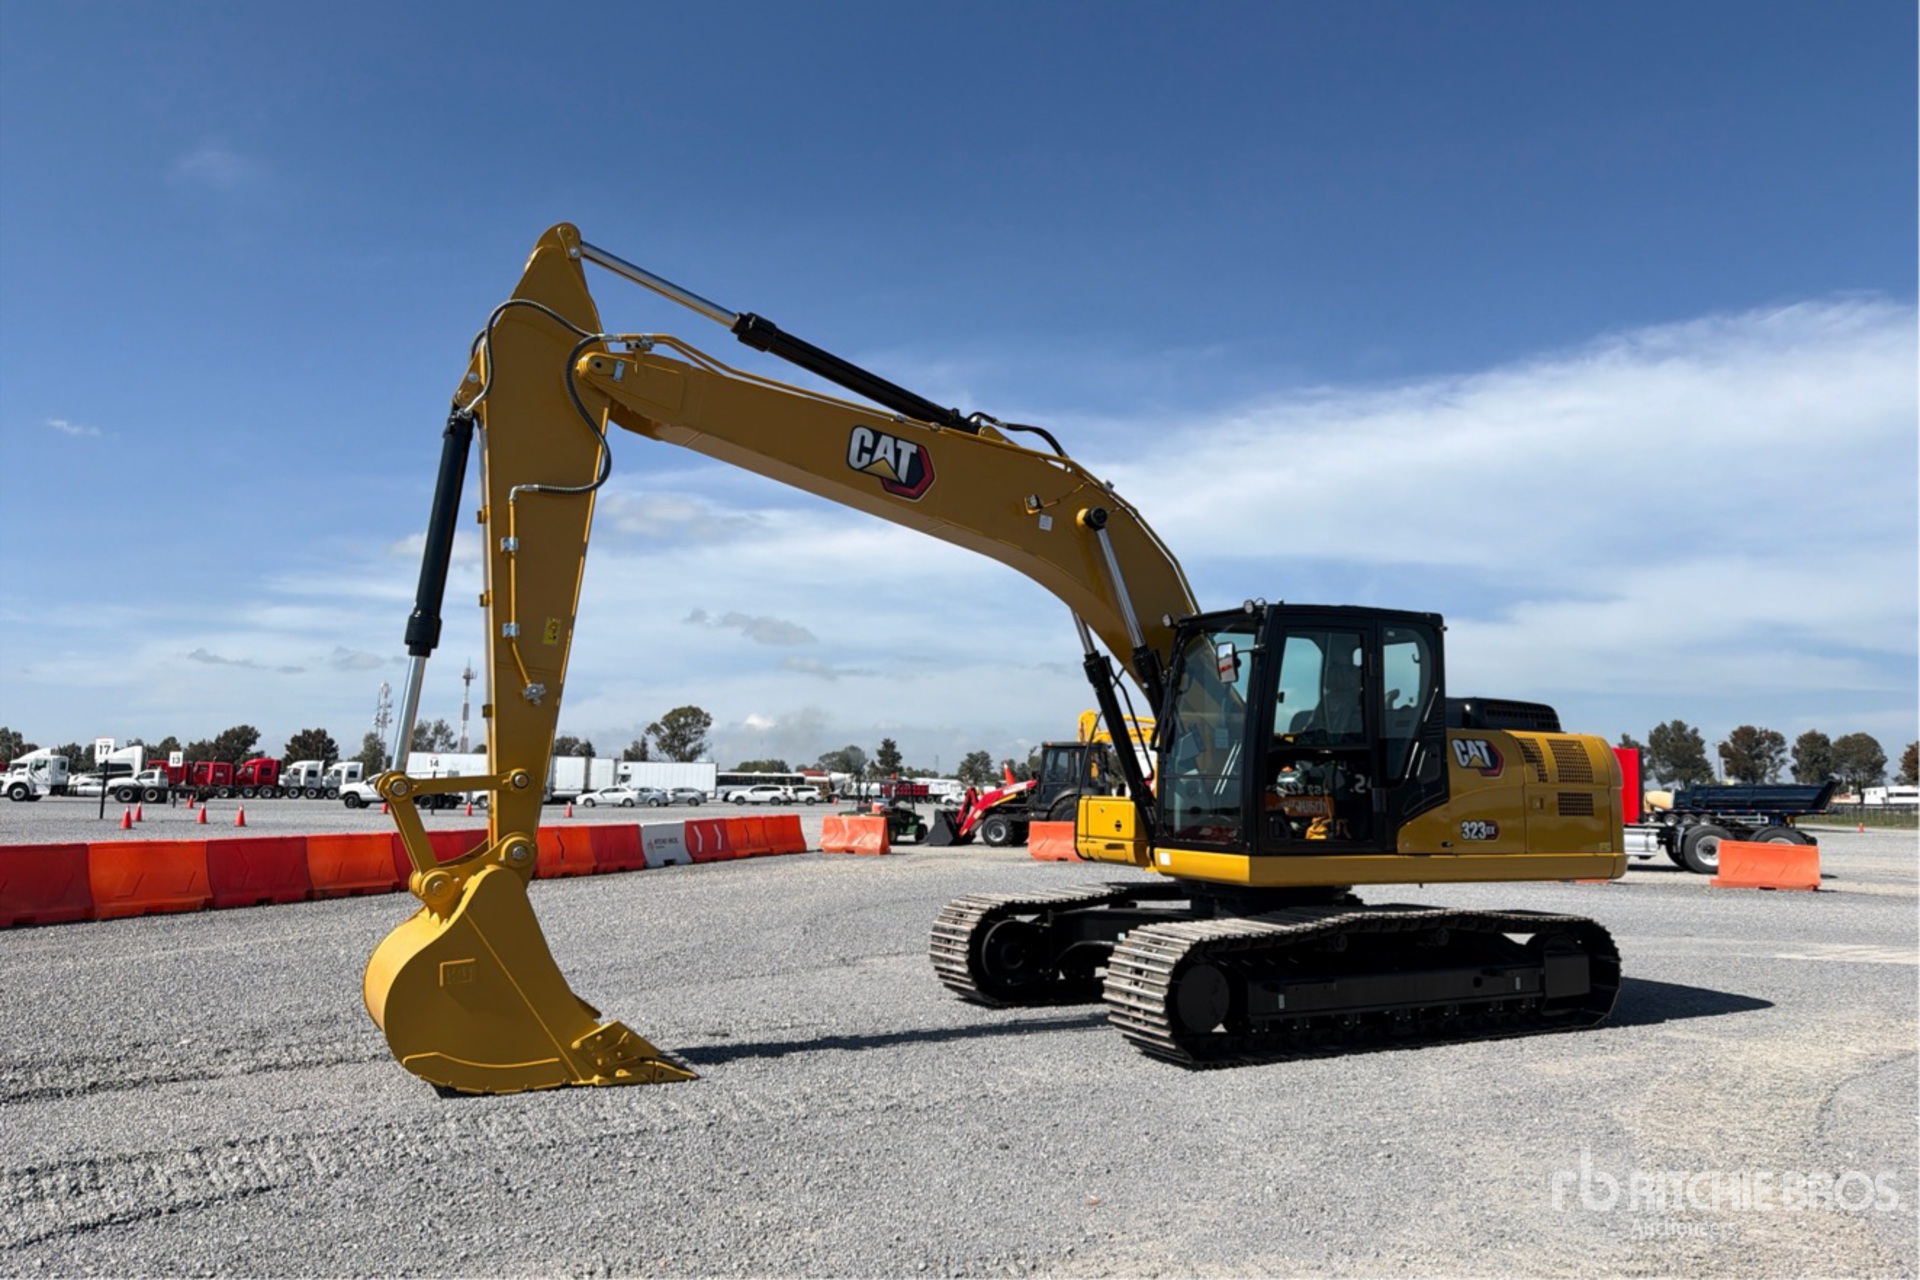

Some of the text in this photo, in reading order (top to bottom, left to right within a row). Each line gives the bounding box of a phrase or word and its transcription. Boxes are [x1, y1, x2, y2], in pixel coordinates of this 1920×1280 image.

[849, 426, 919, 484] CAT
[99, 745, 111, 755] 17
[1452, 739, 1492, 768] CAT
